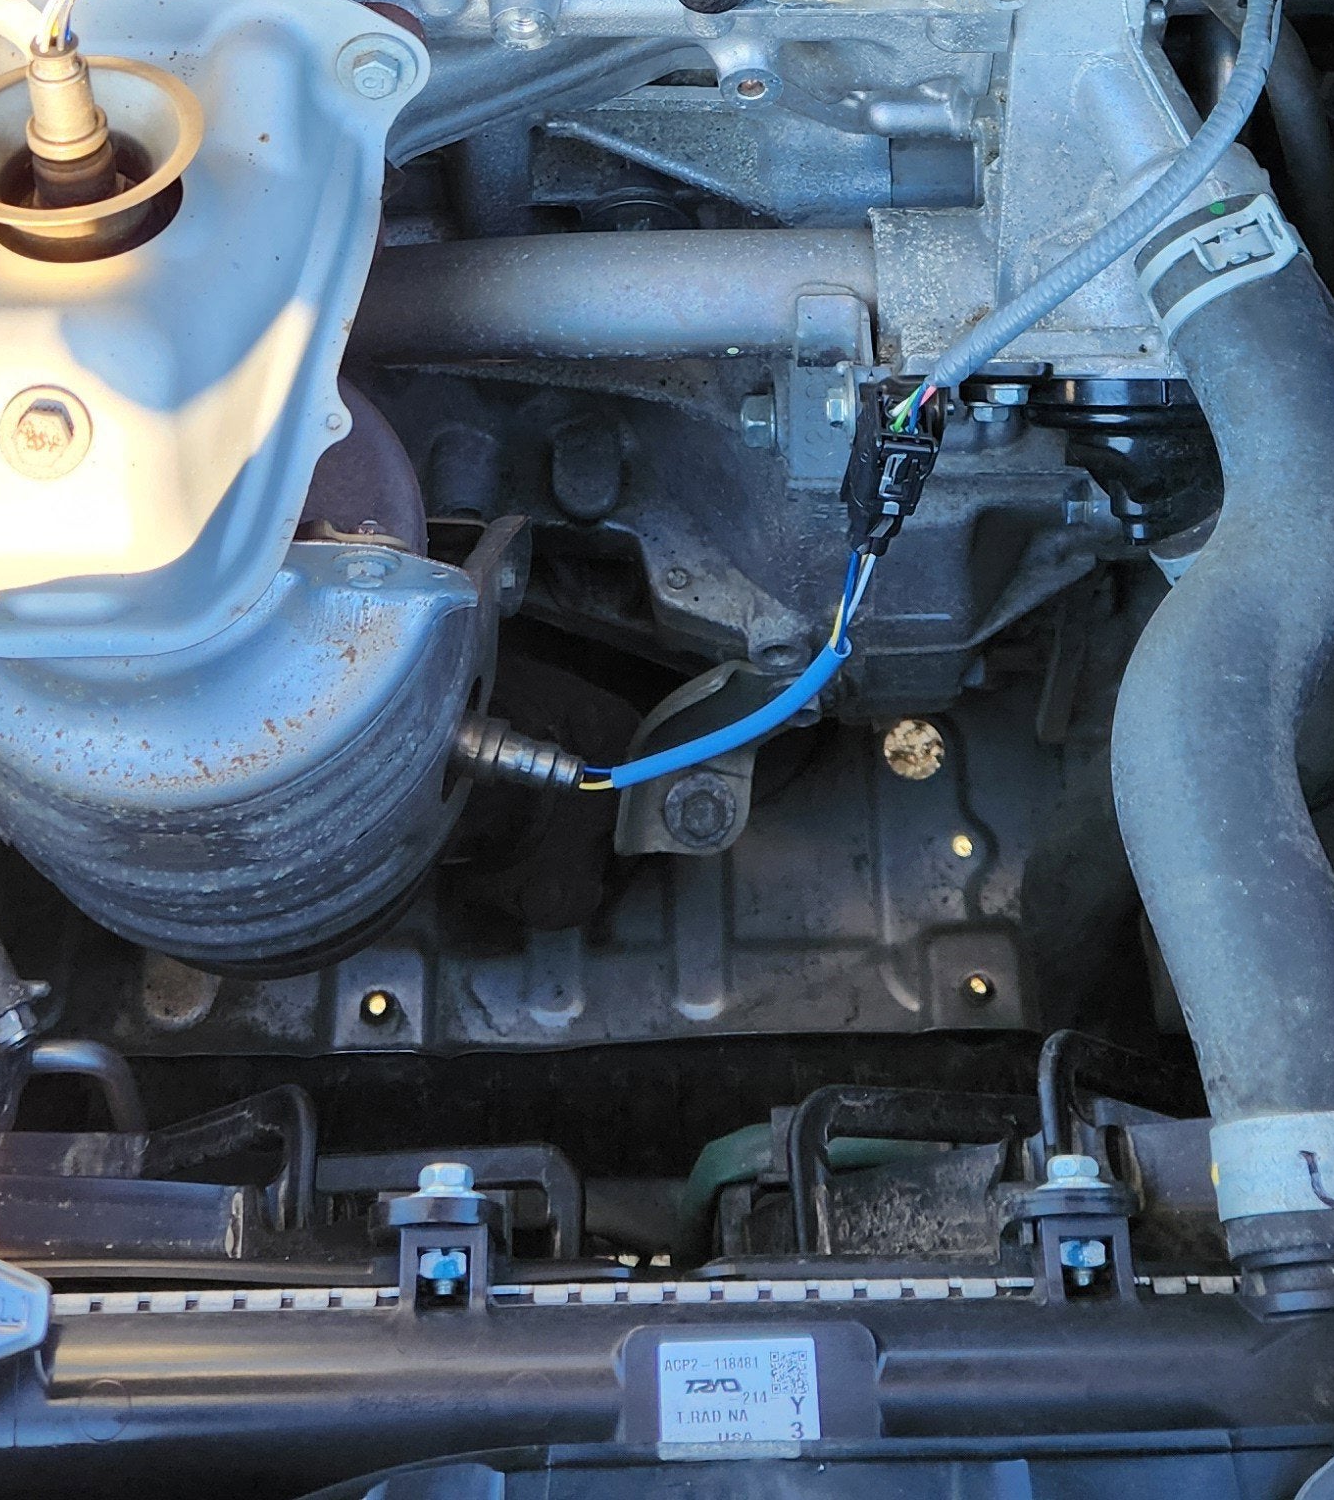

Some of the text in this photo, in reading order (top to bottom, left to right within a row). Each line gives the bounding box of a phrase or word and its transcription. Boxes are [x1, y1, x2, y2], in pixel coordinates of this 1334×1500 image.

[790, 1396, 805, 1415] Y
[676, 1409, 749, 1425] T.RAD NA
[718, 1431, 754, 1442] USA
[790, 1421, 805, 1439] 3
